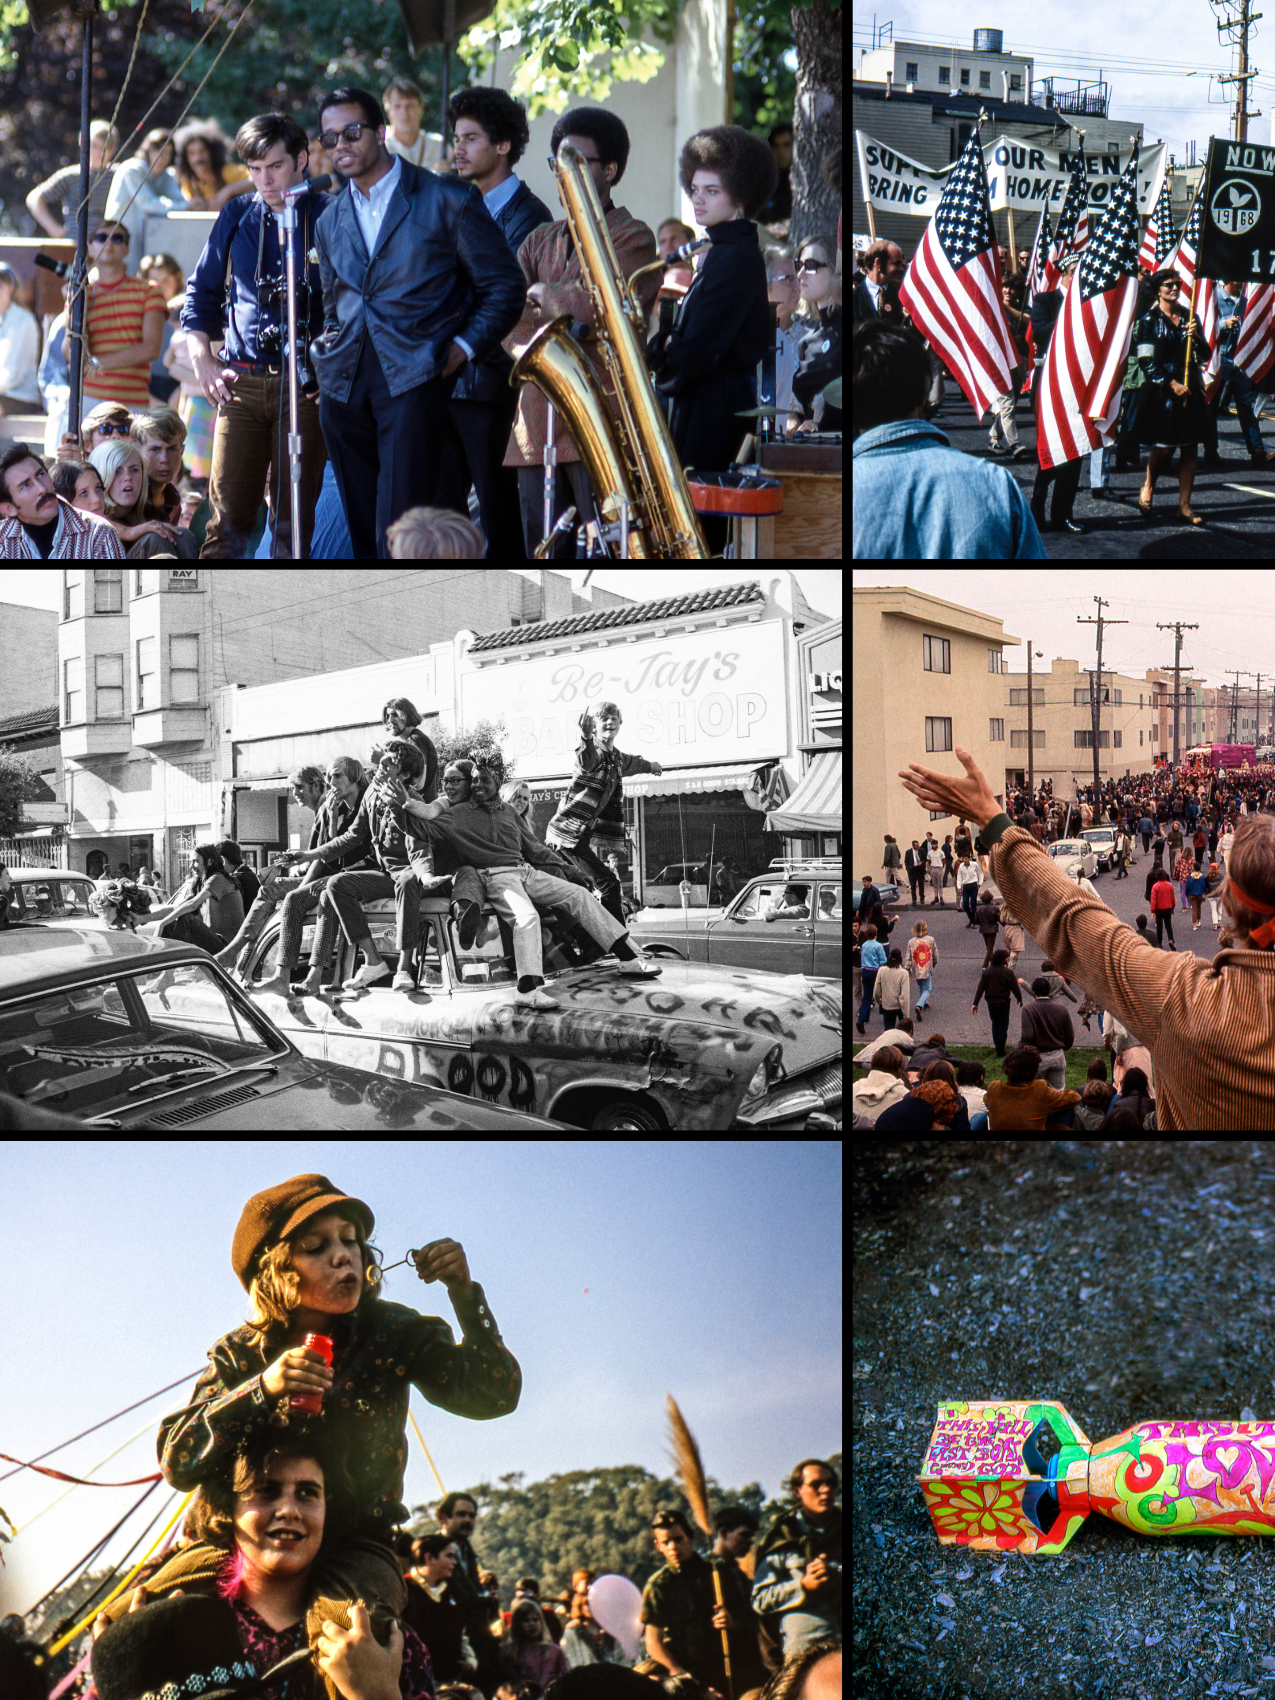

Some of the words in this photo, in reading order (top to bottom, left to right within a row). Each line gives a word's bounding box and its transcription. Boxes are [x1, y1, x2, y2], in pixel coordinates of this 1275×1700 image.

[995, 146, 1045, 171] OUR
[869, 174, 928, 205] BRING
[1006, 175, 1066, 201] HOME
[172, 570, 193, 578] RAY
[548, 650, 741, 703] Be-Jay's
[637, 691, 768, 746] SHOP
